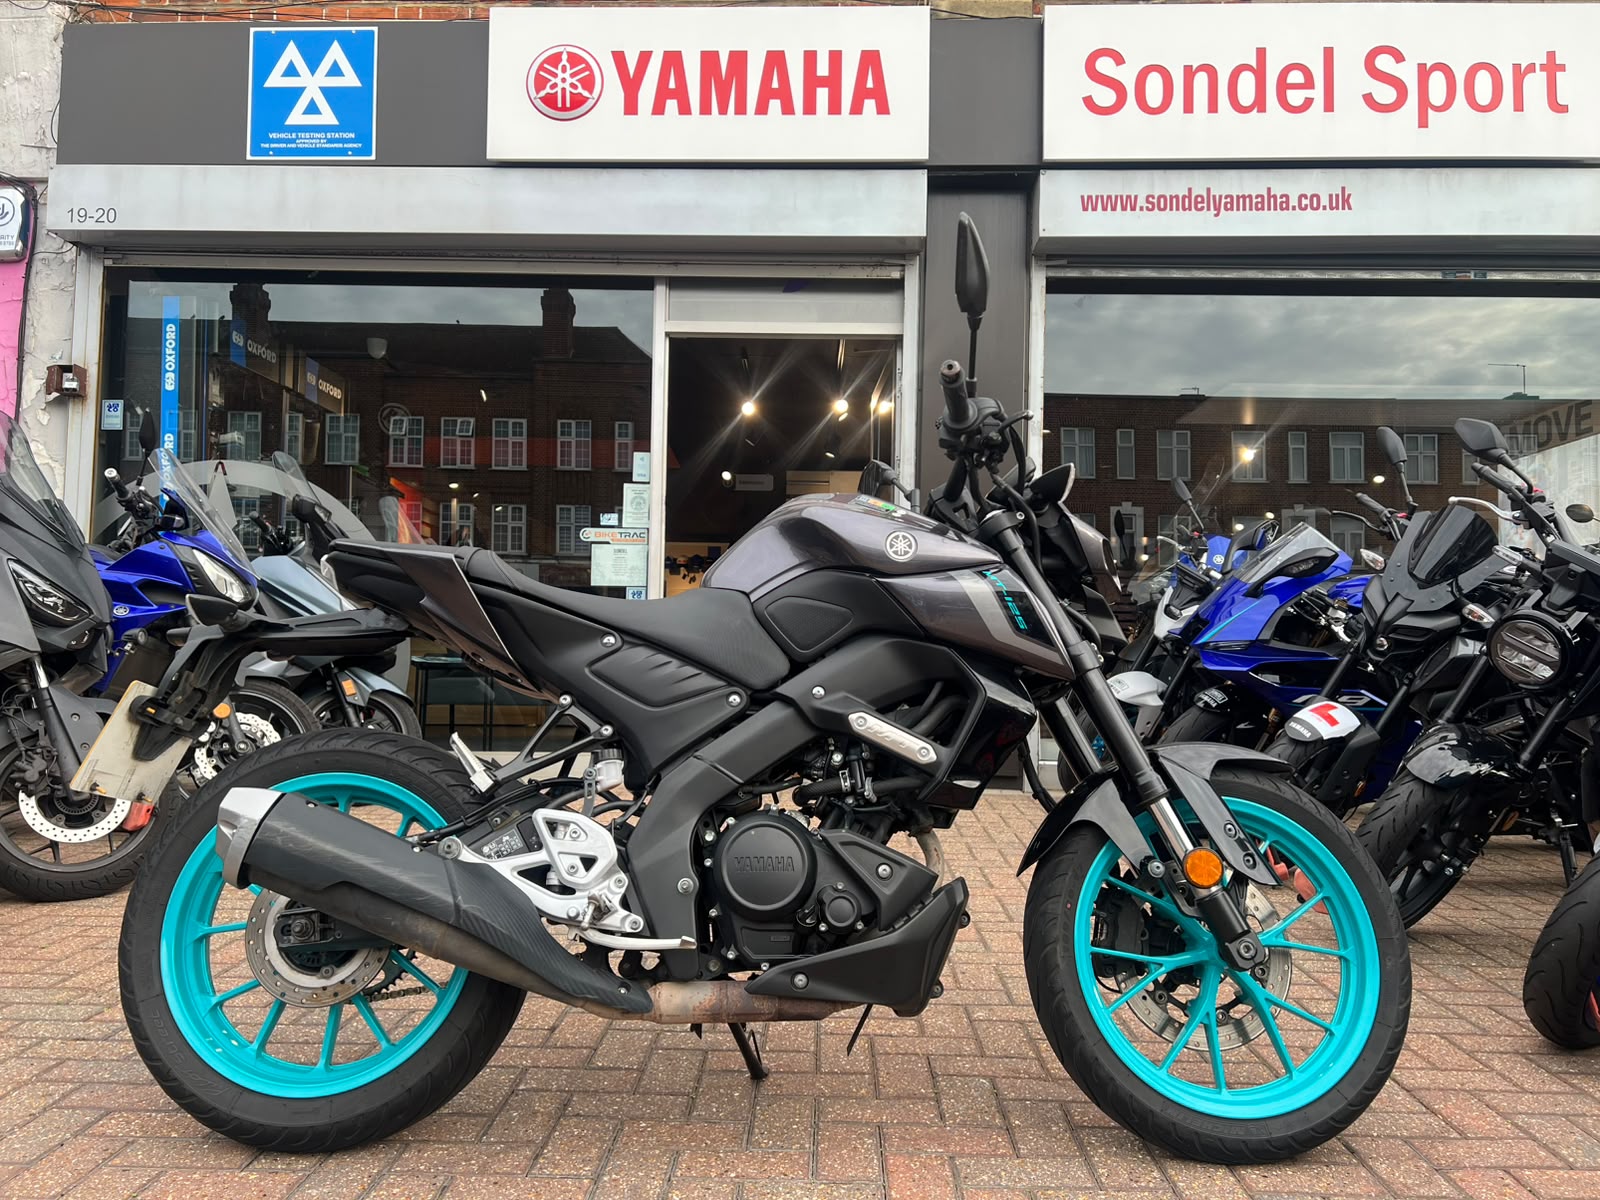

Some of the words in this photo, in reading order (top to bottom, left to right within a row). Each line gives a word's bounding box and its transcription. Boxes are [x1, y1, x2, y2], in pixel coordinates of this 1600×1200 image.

[611, 50, 890, 115] YAMAHA
[1081, 46, 1335, 116] Sondel
[1362, 44, 1569, 129] Sport
[1080, 186, 1353, 217] www.sondelyamaha.co.uk
[66, 208, 118, 224] 19-20
[165, 323, 176, 371] OXFORD
[247, 339, 277, 363] OXFORD
[318, 379, 342, 400] OXFORD
[594, 531, 646, 539] BIKETRAC
[982, 571, 1028, 629] MT-125
[1309, 703, 1340, 728] L
[1289, 721, 1312, 738] YAMAHA
[734, 856, 795, 872] YAMAHA
